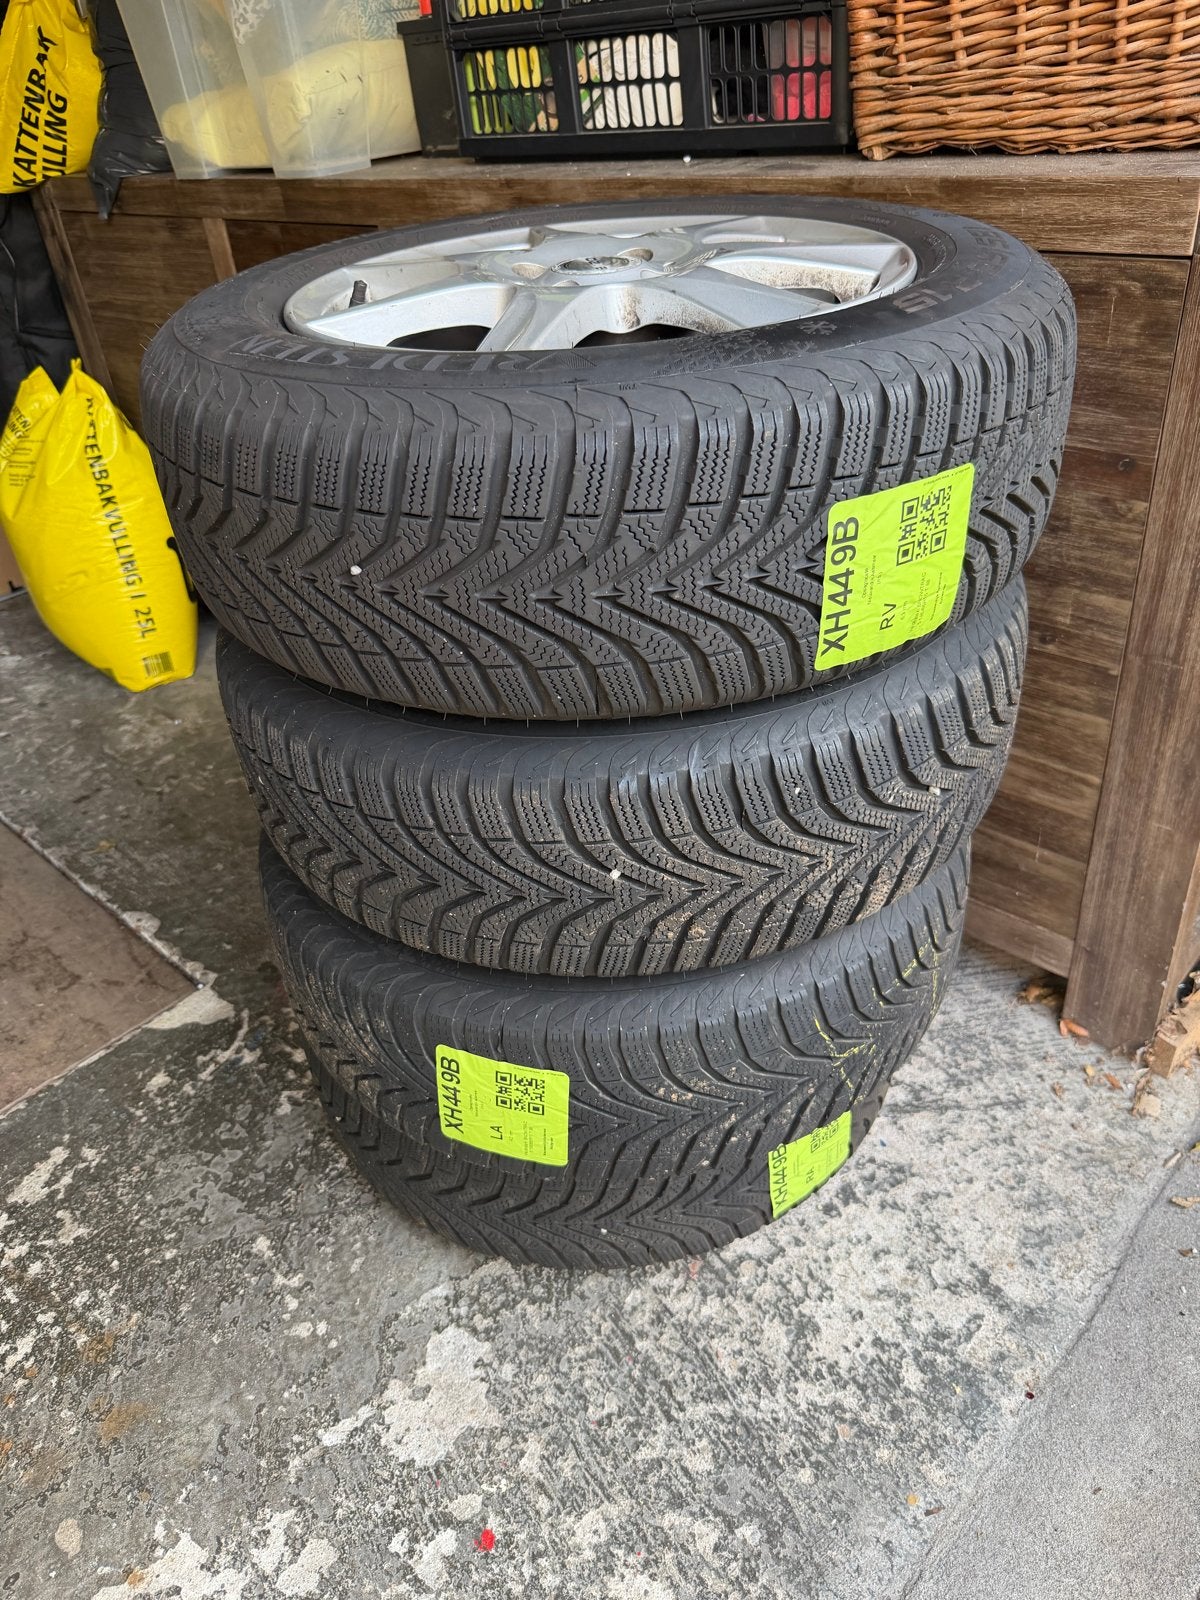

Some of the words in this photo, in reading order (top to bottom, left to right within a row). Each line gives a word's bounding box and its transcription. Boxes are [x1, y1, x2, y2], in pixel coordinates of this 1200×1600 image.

[820, 516, 859, 657] XH449B
[134, 606, 157, 639] 25L
[879, 603, 896, 631] RV
[440, 1056, 464, 1134] XH449B
[490, 1125, 503, 1140] LA
[772, 1145, 788, 1208] XH449B
[806, 1167, 815, 1183] RA
